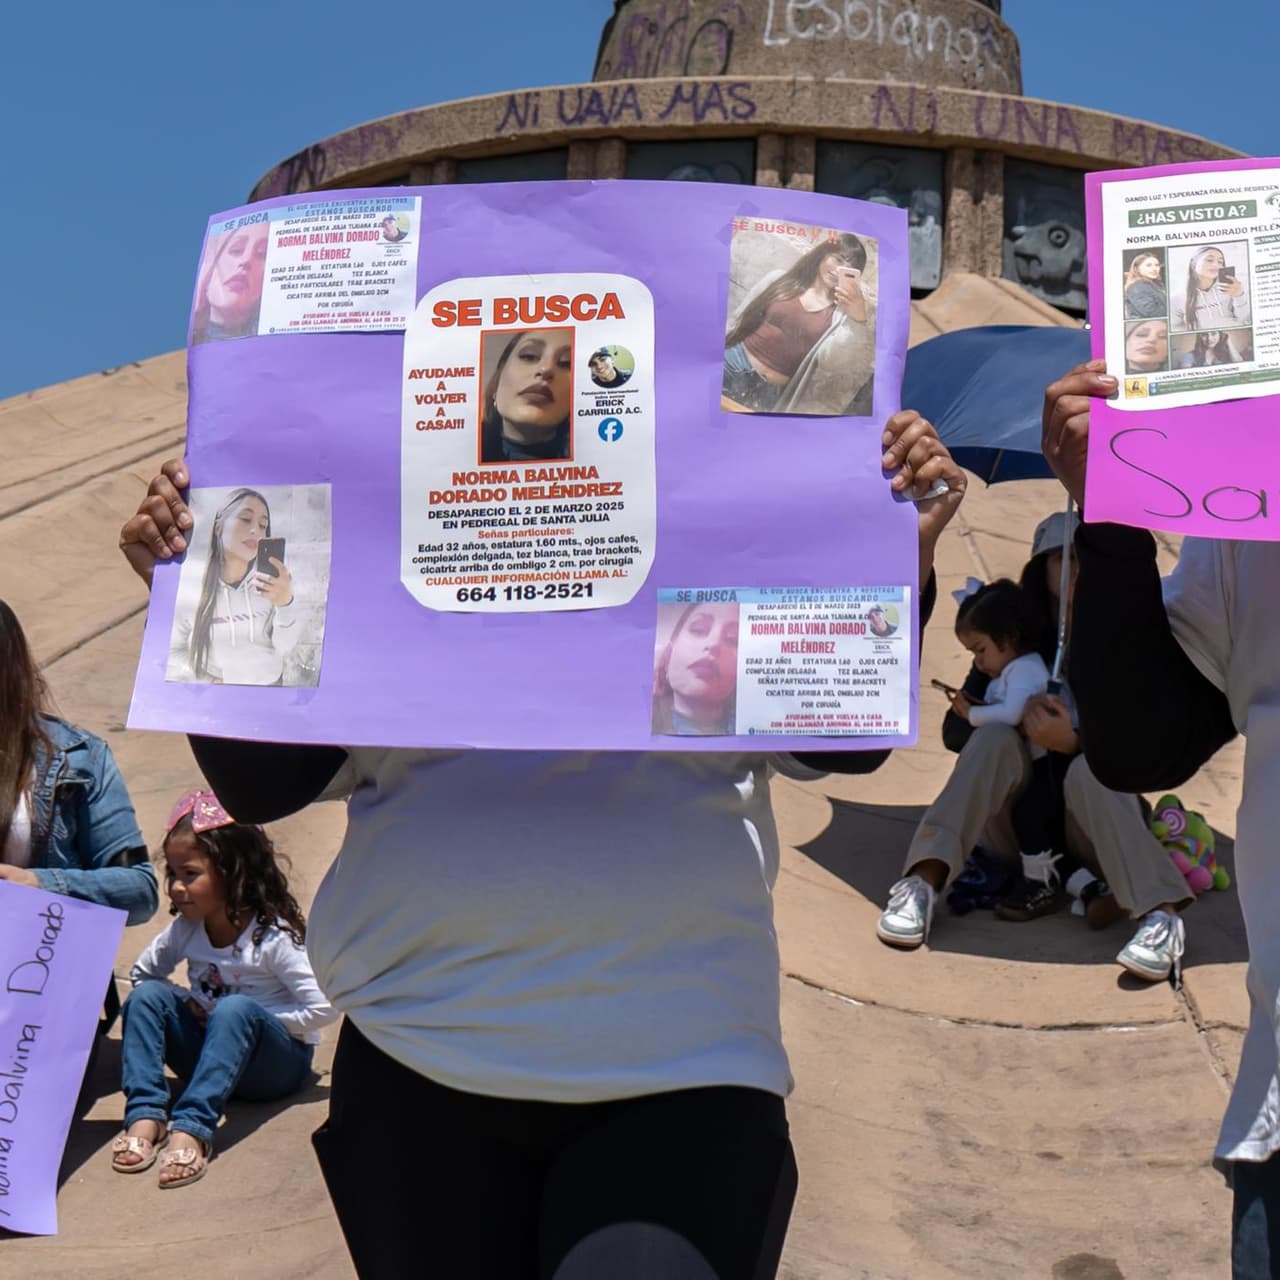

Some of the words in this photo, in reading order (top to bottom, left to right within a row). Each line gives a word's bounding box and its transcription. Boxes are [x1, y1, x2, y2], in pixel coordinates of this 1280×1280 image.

[658, 81, 757, 120] MAS
[975, 96, 1083, 154] UNA
[1169, 190, 1208, 199] ESPERANZA
[224, 222, 236, 231] SE
[238, 212, 268, 227] BUSCA
[1137, 210, 1175, 225] ¿HAS
[1179, 207, 1224, 223] VISTO
[1228, 205, 1247, 218] A?
[754, 222, 807, 237] BUSCA
[1127, 234, 1160, 244] NORMA
[1166, 230, 1206, 241] BALVINA
[1209, 227, 1248, 237] DORADO
[278, 233, 306, 248] NORMA
[309, 232, 344, 244] BALVINA
[346, 231, 379, 242] DORADO
[302, 247, 351, 262] MELÉNDREZ
[432, 299, 482, 327] SE
[493, 293, 625, 324] BUSCA
[408, 367, 475, 380] AYUDAME
[437, 381, 446, 391] A
[415, 394, 466, 405] VOLVER
[596, 399, 624, 407] ERICK
[436, 407, 445, 416] A
[578, 408, 622, 416] CARRILLO
[452, 471, 520, 486] NORMA
[525, 466, 599, 482] BALVINA
[429, 488, 506, 505] DORADO
[512, 482, 623, 501] MELÉNDREZ
[428, 508, 505, 519] DESAPARECIO
[509, 506, 522, 516] EL
[525, 506, 531, 514] 2
[535, 505, 550, 514] DE
[553, 503, 592, 513] MARZO
[596, 501, 624, 511] 2025
[443, 520, 458, 529] EN
[461, 517, 519, 528] PEDREGAL
[522, 516, 537, 526] DE
[541, 515, 576, 525] SANTA
[579, 513, 610, 523] JULIA
[478, 529, 509, 539] Señas
[511, 527, 574, 539] particulares:
[418, 543, 443, 553] Edad
[446, 543, 459, 551] 32
[462, 541, 488, 552] años,
[491, 539, 532, 549] estatura
[536, 537, 555, 547] 1.60
[584, 535, 606, 546] ojos
[471, 551, 514, 563] delgada,
[517, 551, 532, 560] tez
[534, 548, 570, 559] blanca,
[573, 547, 592, 556] trae
[595, 544, 642, 556] brackets,
[420, 564, 456, 574] cicatriz
[459, 562, 489, 572] arriba
[492, 561, 504, 571] de
[507, 559, 547, 572] ombligo
[550, 560, 556, 568] 2
[579, 558, 596, 569] por
[426, 575, 488, 586] CUALQUIER
[491, 570, 570, 584] INFORMACIÓN
[573, 569, 608, 580] LLAMA
[612, 569, 628, 578] AL:
[457, 587, 496, 603] 664
[503, 582, 593, 601] 118-2521
[677, 591, 693, 602] SE
[696, 590, 737, 602] BUSCA
[751, 623, 784, 635] NORMA
[788, 622, 826, 635] BALVINA
[830, 622, 866, 635] DORADO
[781, 638, 835, 653] MELÉNDREZ
[7, 901, 64, 996] Dorado
